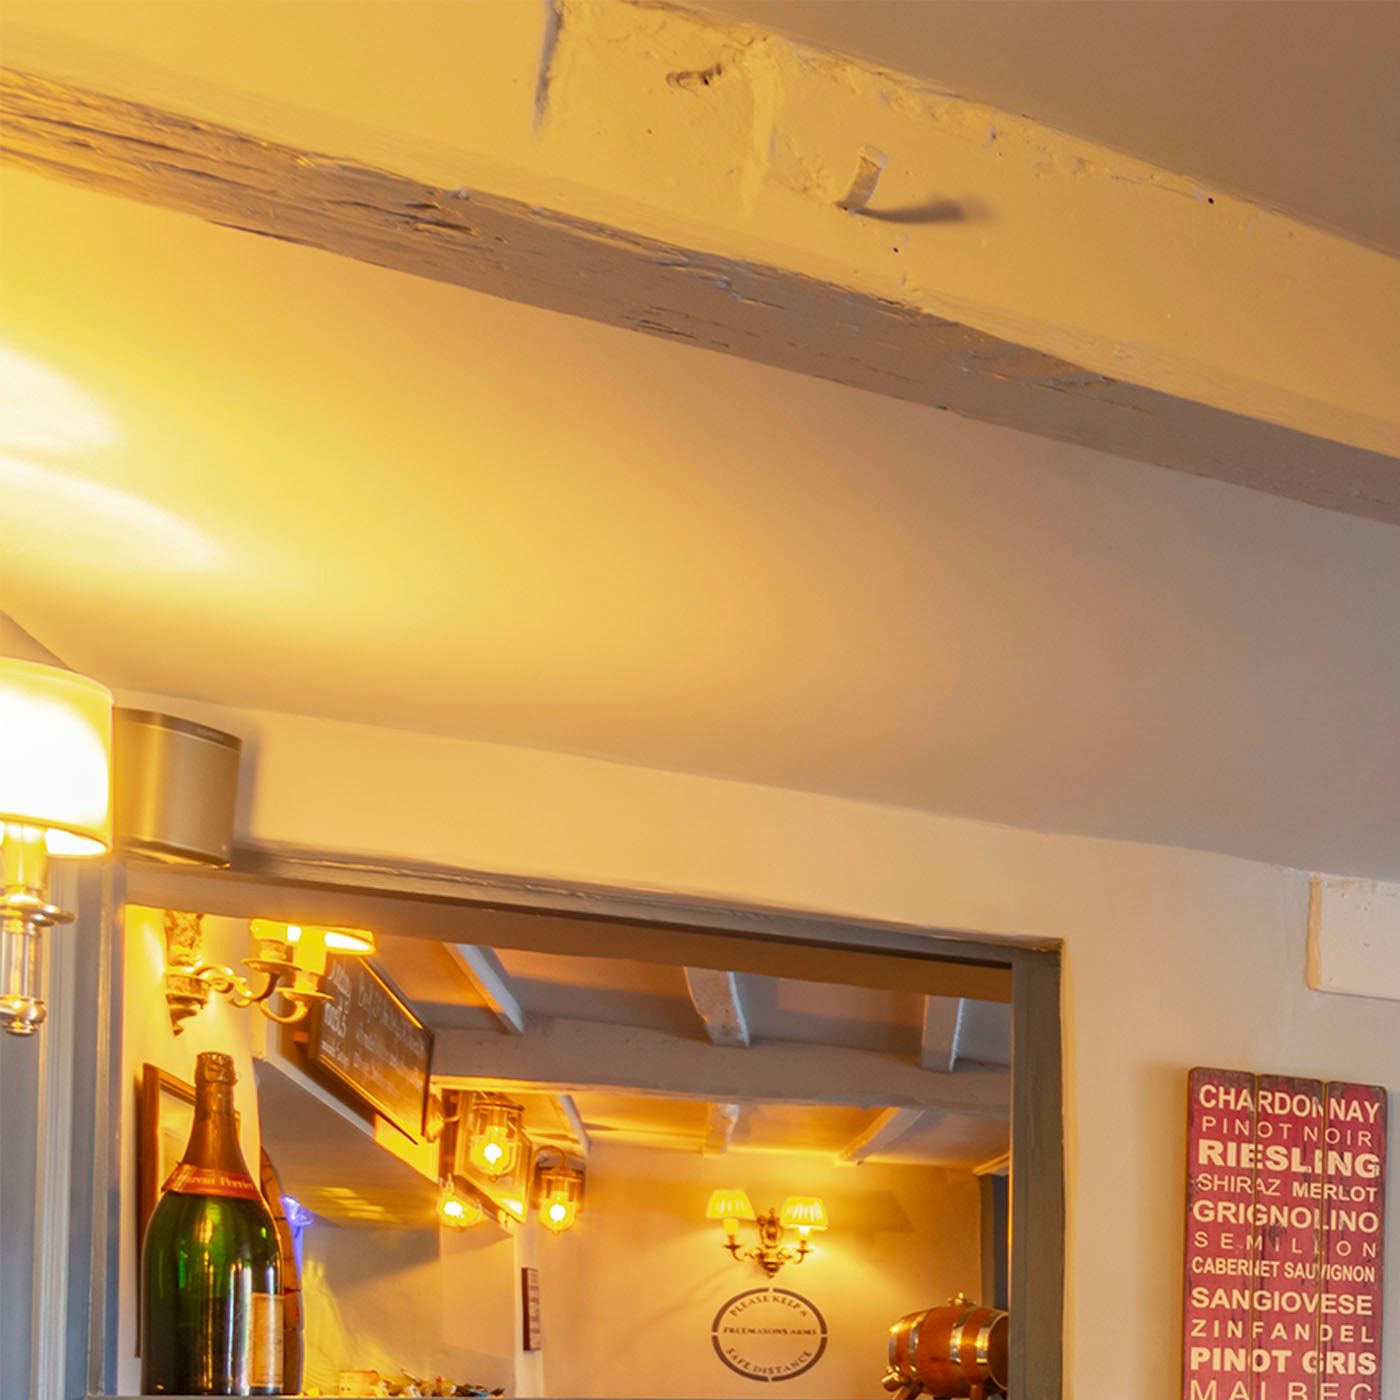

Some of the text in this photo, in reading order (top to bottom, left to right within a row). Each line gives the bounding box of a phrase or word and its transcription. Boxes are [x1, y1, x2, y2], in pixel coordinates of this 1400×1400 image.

[1199, 1084, 1381, 1124] CHARDONNAY
[1201, 1115, 1373, 1147] PINOT NOIR
[1198, 1139, 1381, 1178] RIESLING
[1197, 1173, 1378, 1203] SHIRAZ MERLOT
[1192, 1200, 1379, 1233] GRIGNOLINO
[1191, 1256, 1375, 1282] CABERNET SAUVIGNON
[730, 1295, 769, 1317] PLEASE
[772, 1295, 802, 1310] KEEP
[1190, 1287, 1373, 1315] SANGIOVESE
[1190, 1319, 1374, 1343] ZINFANDEL
[725, 1347, 813, 1375] SAFE DISTANCE
[1190, 1347, 1377, 1376] PINOT GRIS
